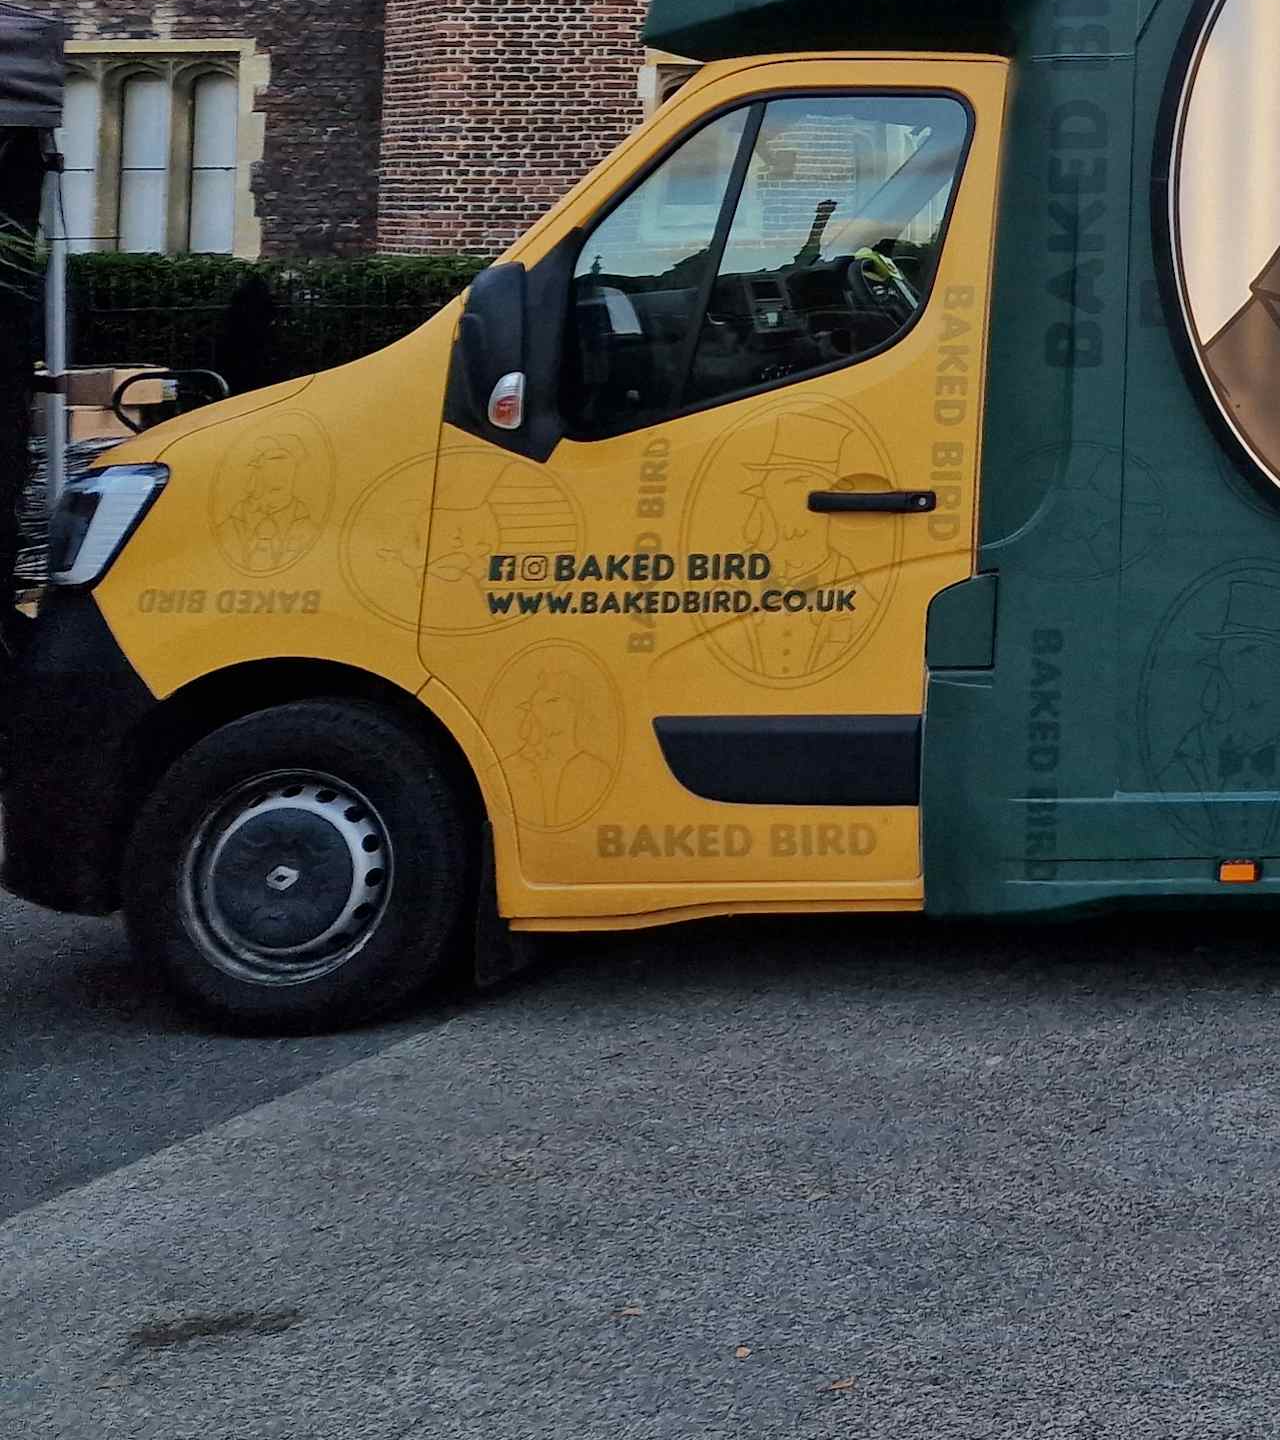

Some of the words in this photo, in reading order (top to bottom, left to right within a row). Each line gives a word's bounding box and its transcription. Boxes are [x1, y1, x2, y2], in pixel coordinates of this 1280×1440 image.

[1044, 98, 1108, 370] BAKED
[932, 285, 976, 427] BAKED
[636, 437, 671, 520] BIRD
[927, 441, 965, 543] BIRD
[553, 554, 676, 583] BAKED
[686, 553, 772, 582] BIRD
[137, 588, 207, 614] BIRD
[217, 588, 321, 615] BAKED
[486, 588, 858, 616] WWW.BAKEDBIRD.CO.UK
[1026, 628, 1065, 773] BAKED
[597, 823, 754, 859] BAKED
[768, 821, 879, 857] BIRD
